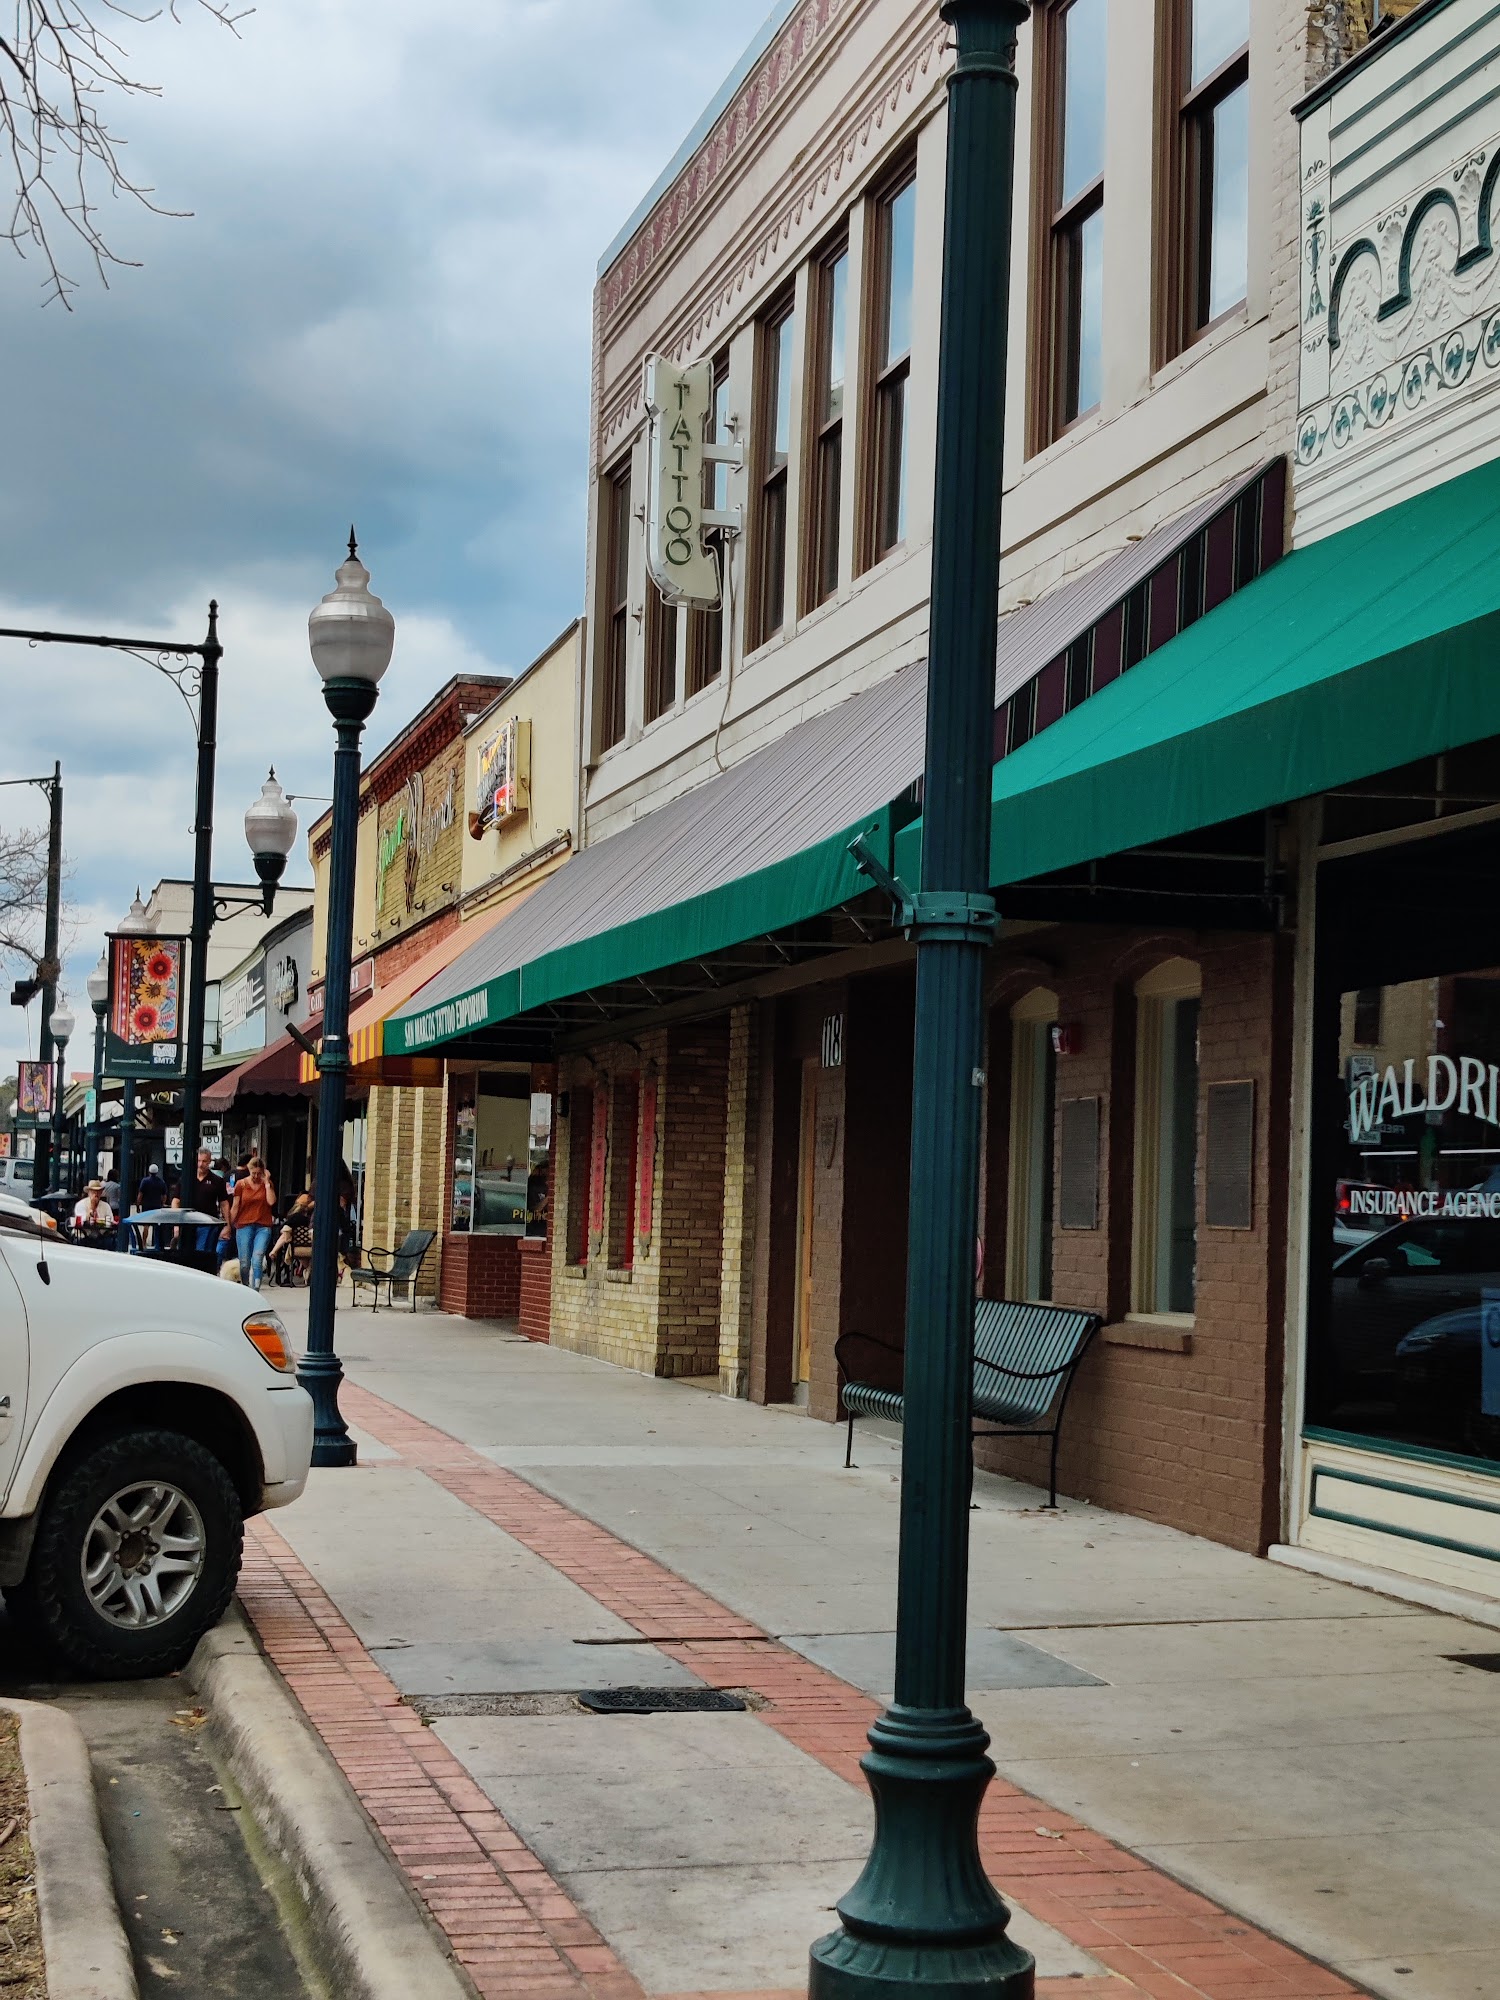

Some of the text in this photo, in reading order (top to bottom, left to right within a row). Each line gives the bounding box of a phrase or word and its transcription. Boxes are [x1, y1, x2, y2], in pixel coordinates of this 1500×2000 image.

[665, 382, 693, 566] TATTOO
[404, 988, 488, 1047] SAN MARCOS TATTOO EMPORIUM
[821, 1013, 843, 1068] 118
[153, 1057, 175, 1065] SMTX
[1349, 1055, 1500, 1142] WALDRI
[169, 1136, 184, 1146] 82
[204, 1126, 217, 1135] BAR
[206, 1135, 220, 1144] 80
[1350, 1190, 1440, 1215] INSURANCE
